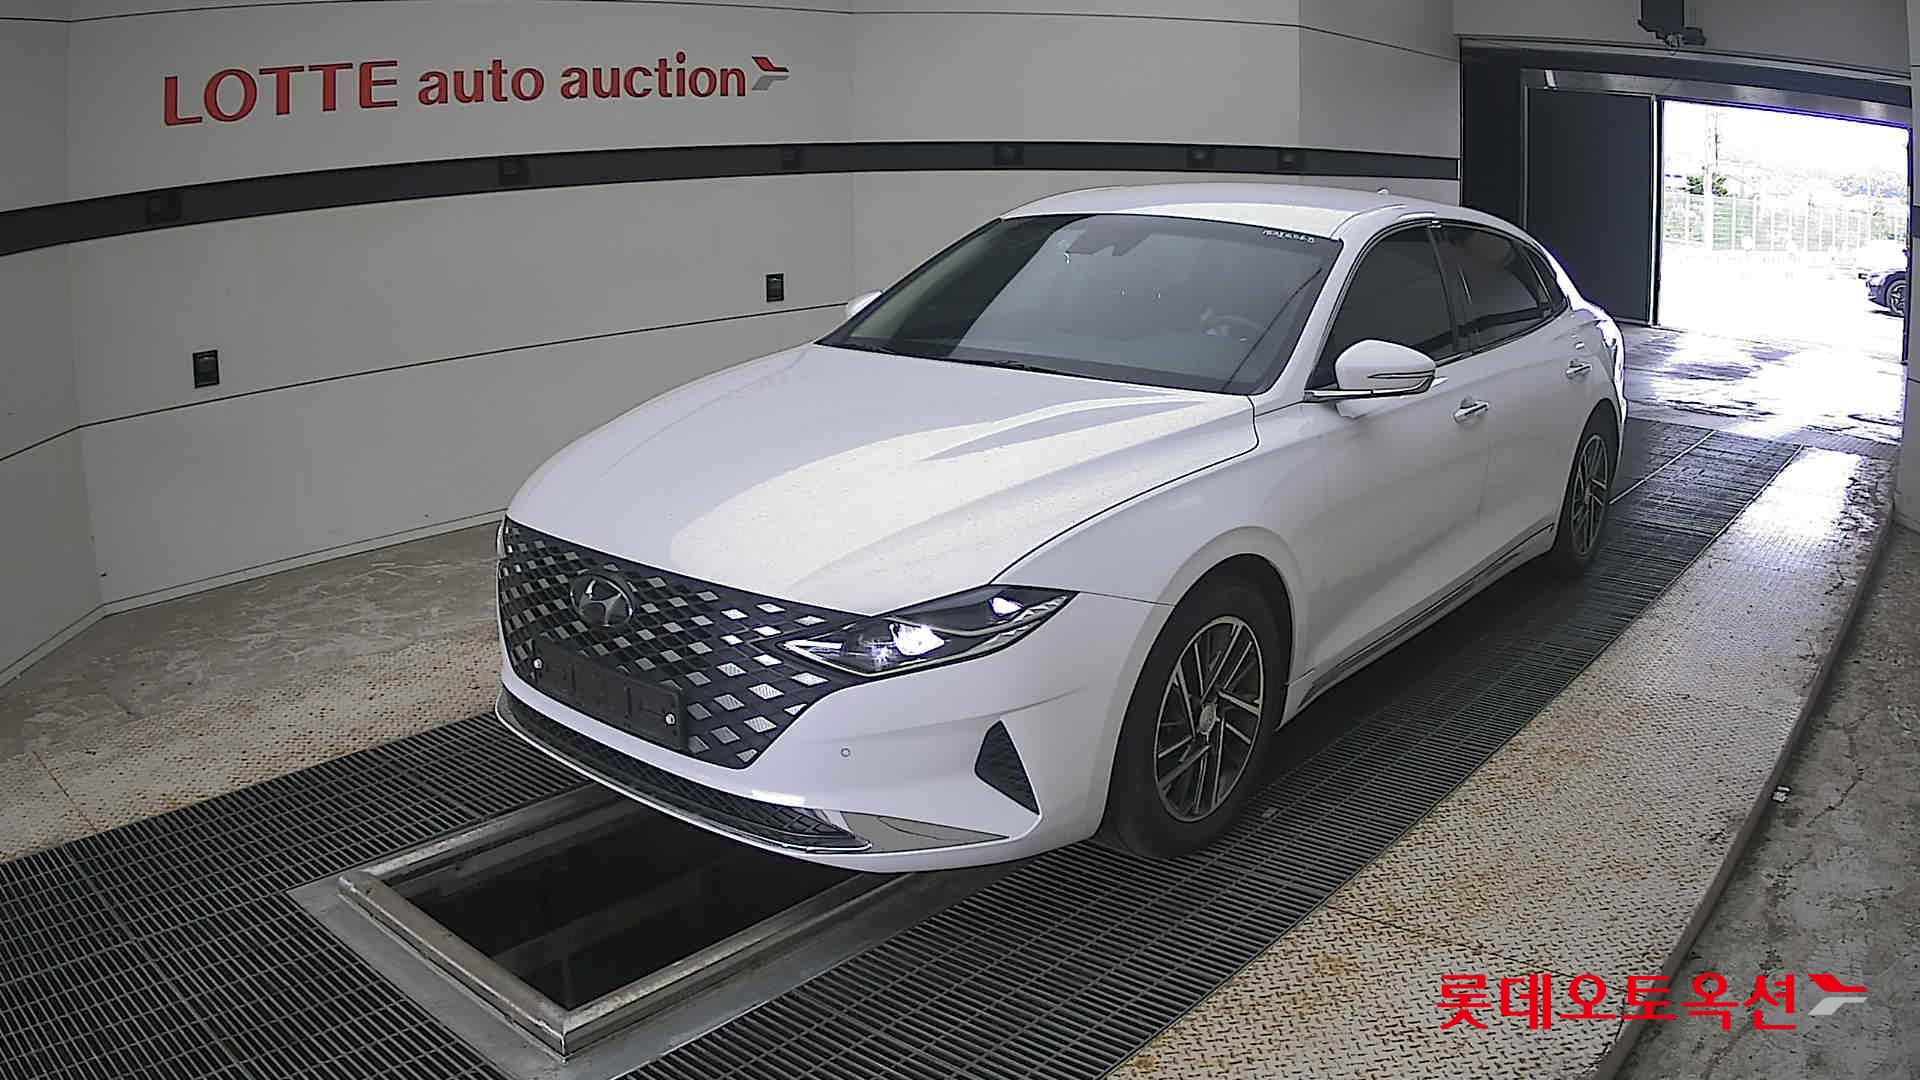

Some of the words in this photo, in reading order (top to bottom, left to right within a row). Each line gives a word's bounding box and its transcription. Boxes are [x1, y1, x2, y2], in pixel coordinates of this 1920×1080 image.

[164, 61, 398, 126] LOTTE
[417, 59, 545, 106] auto
[560, 51, 746, 100] auction
